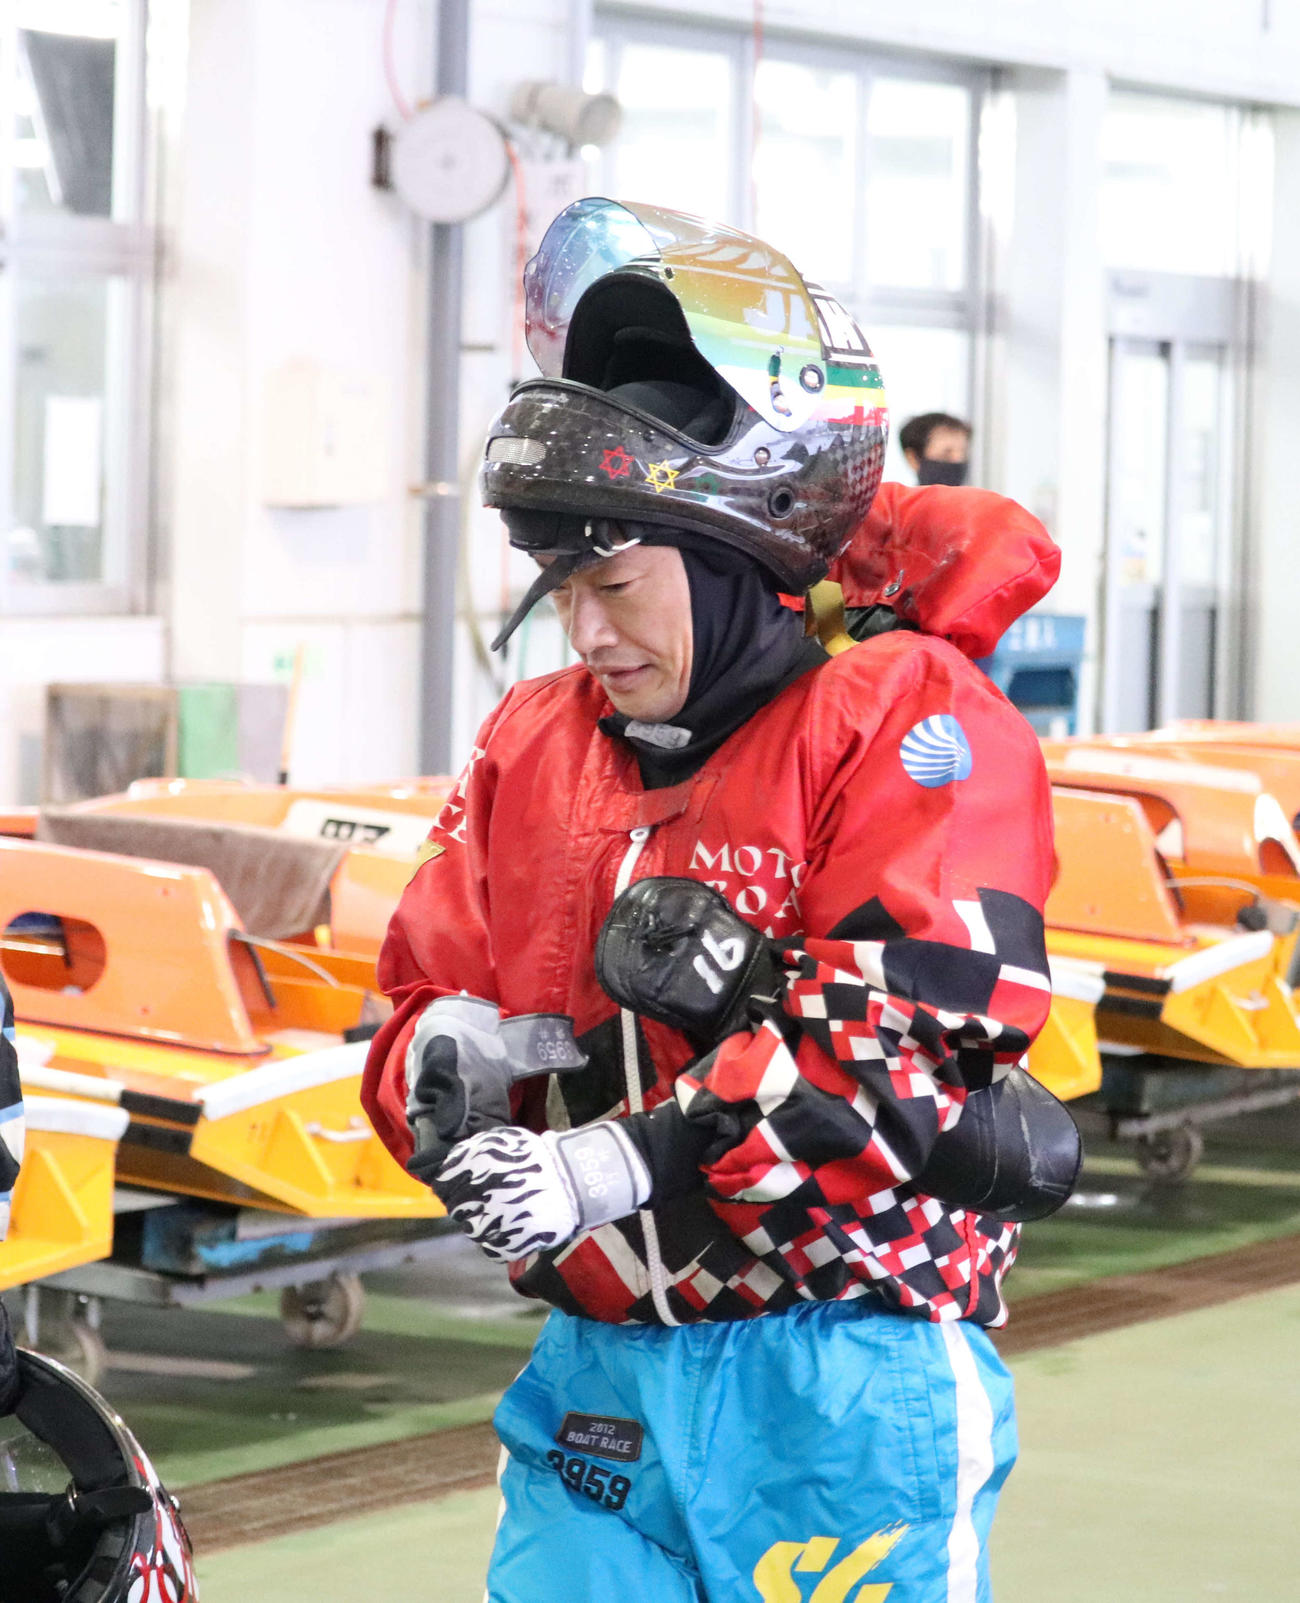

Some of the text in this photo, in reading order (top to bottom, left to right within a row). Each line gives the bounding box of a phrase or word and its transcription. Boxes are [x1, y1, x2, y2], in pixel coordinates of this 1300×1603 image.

[590, 1423, 615, 1435] 2012
[567, 1432, 632, 1453] BOAT RACE
[547, 1450, 631, 1510] 3959
